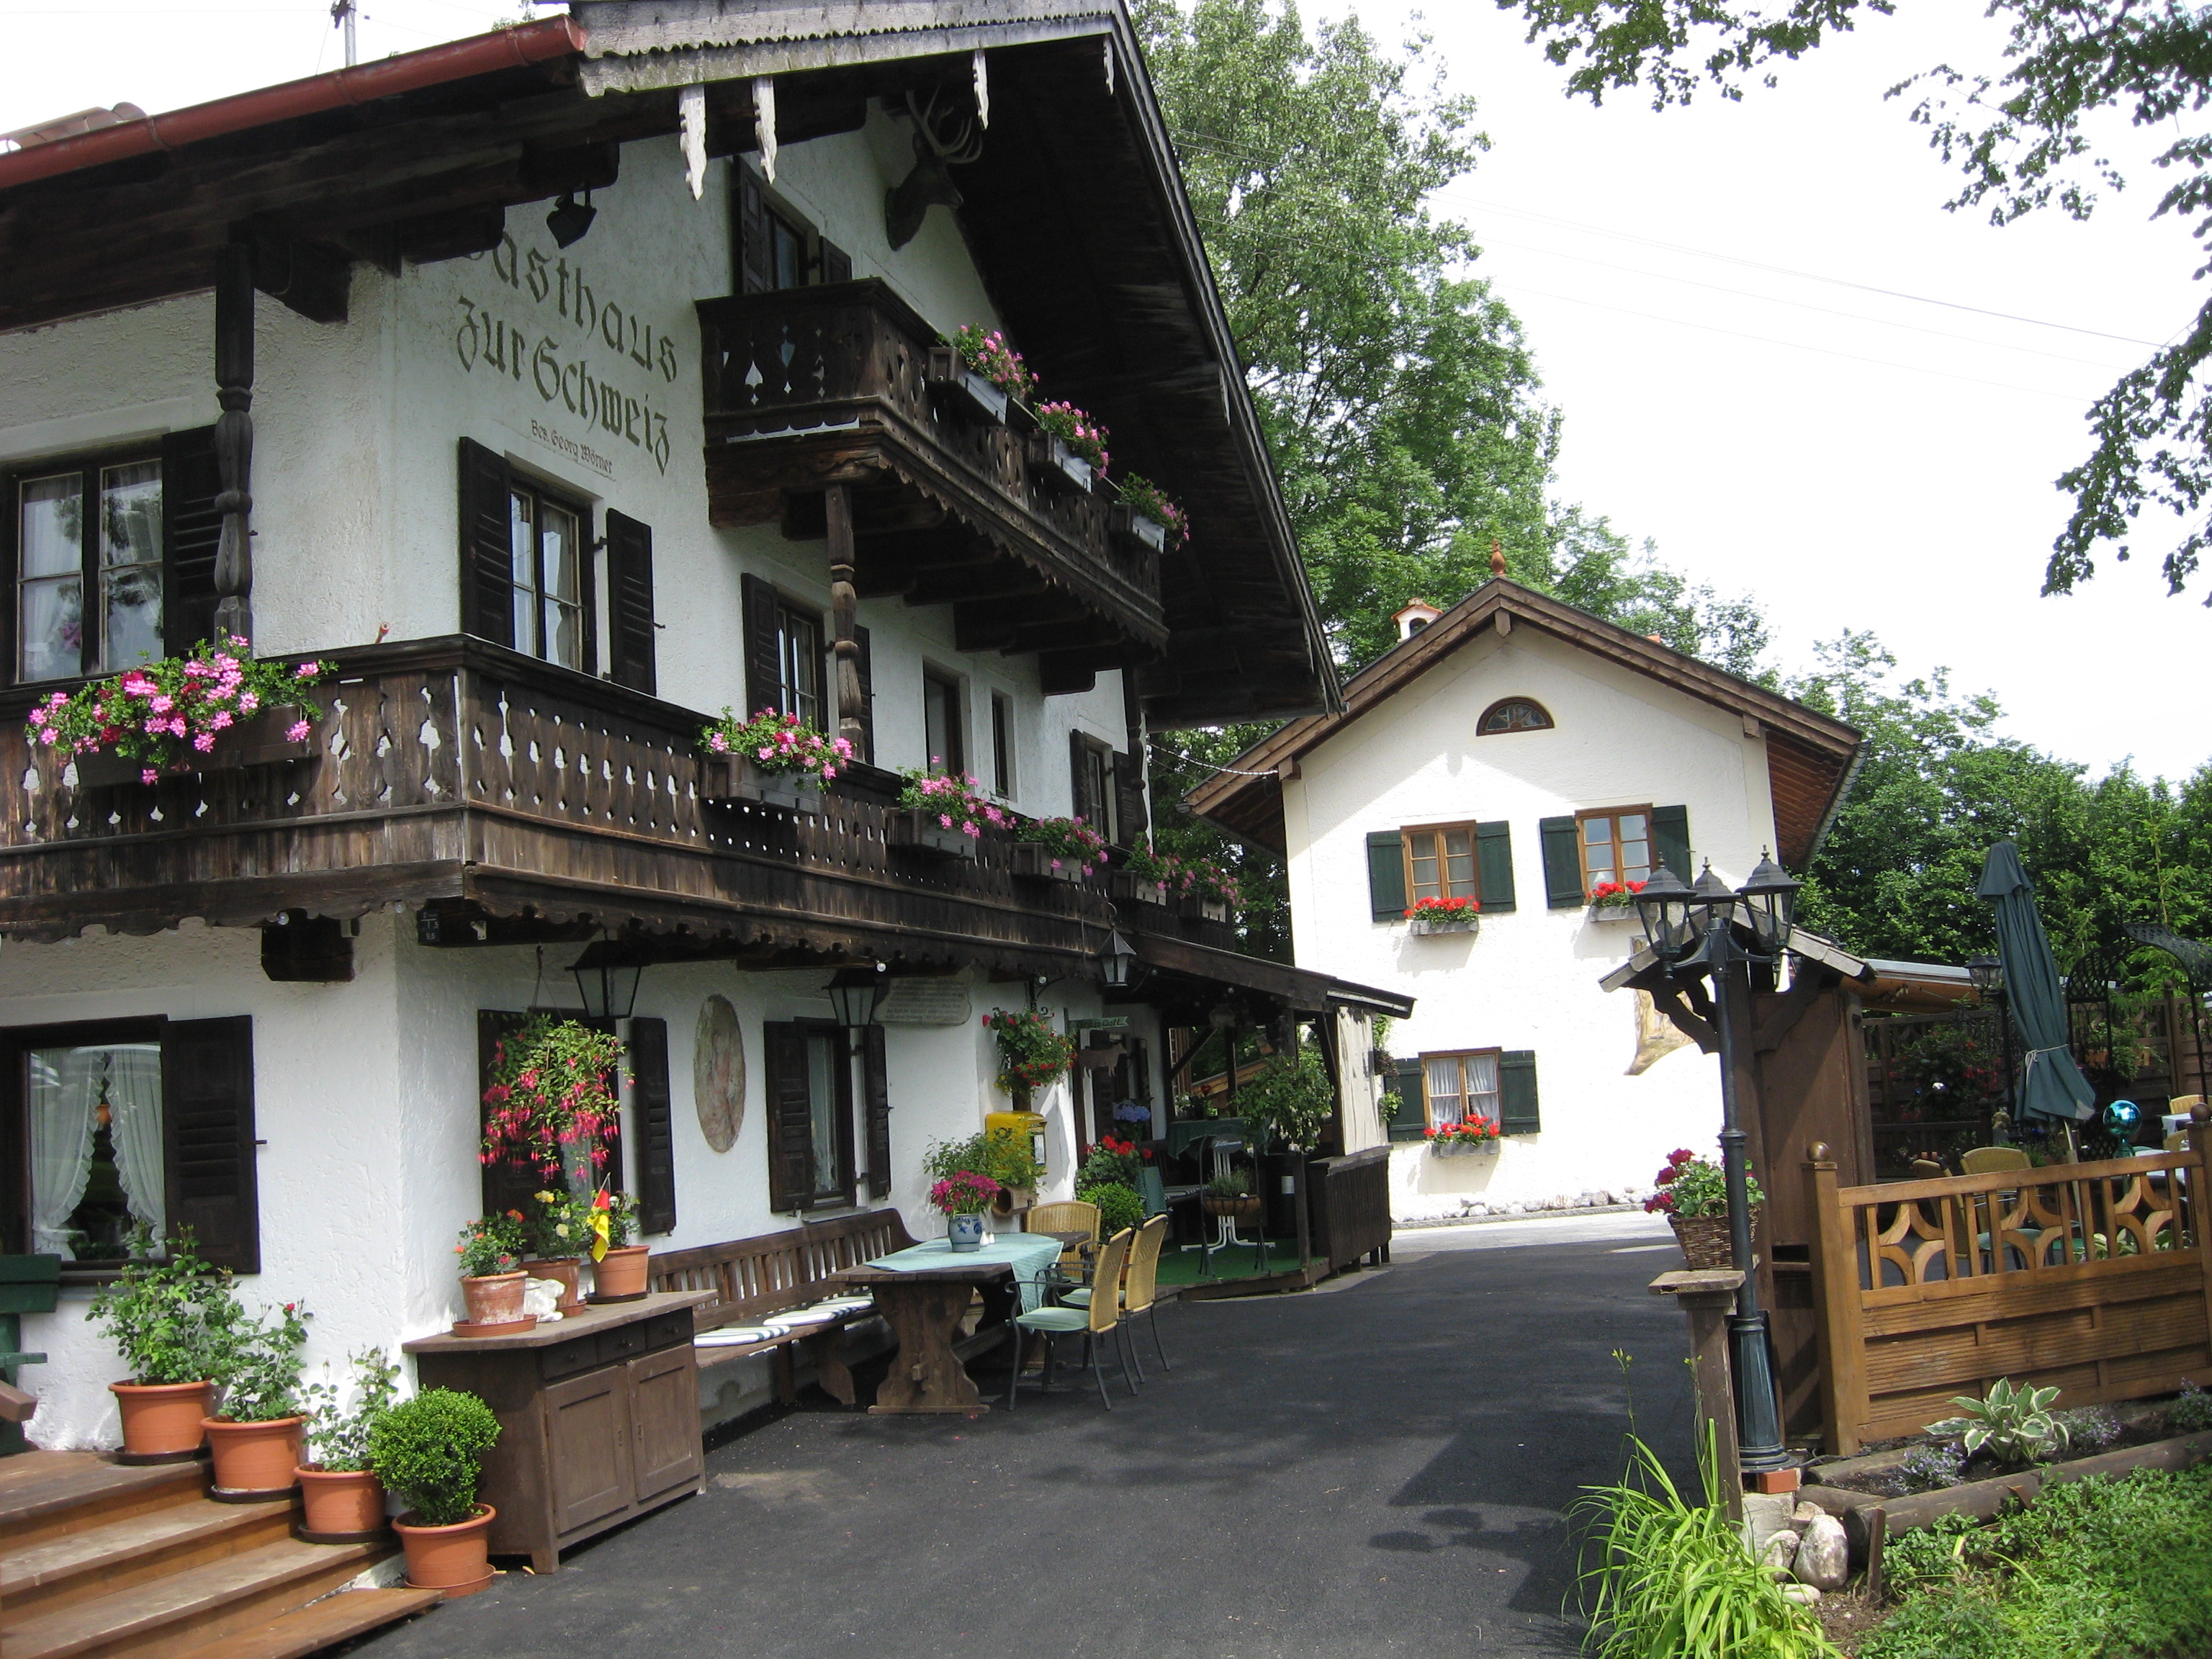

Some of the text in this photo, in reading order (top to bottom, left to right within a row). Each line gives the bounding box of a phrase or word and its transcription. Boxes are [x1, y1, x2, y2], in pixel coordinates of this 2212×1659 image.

[465, 229, 678, 383] asthaus
[532, 335, 670, 477] Schweiz
[550, 430, 578, 462] Georg
